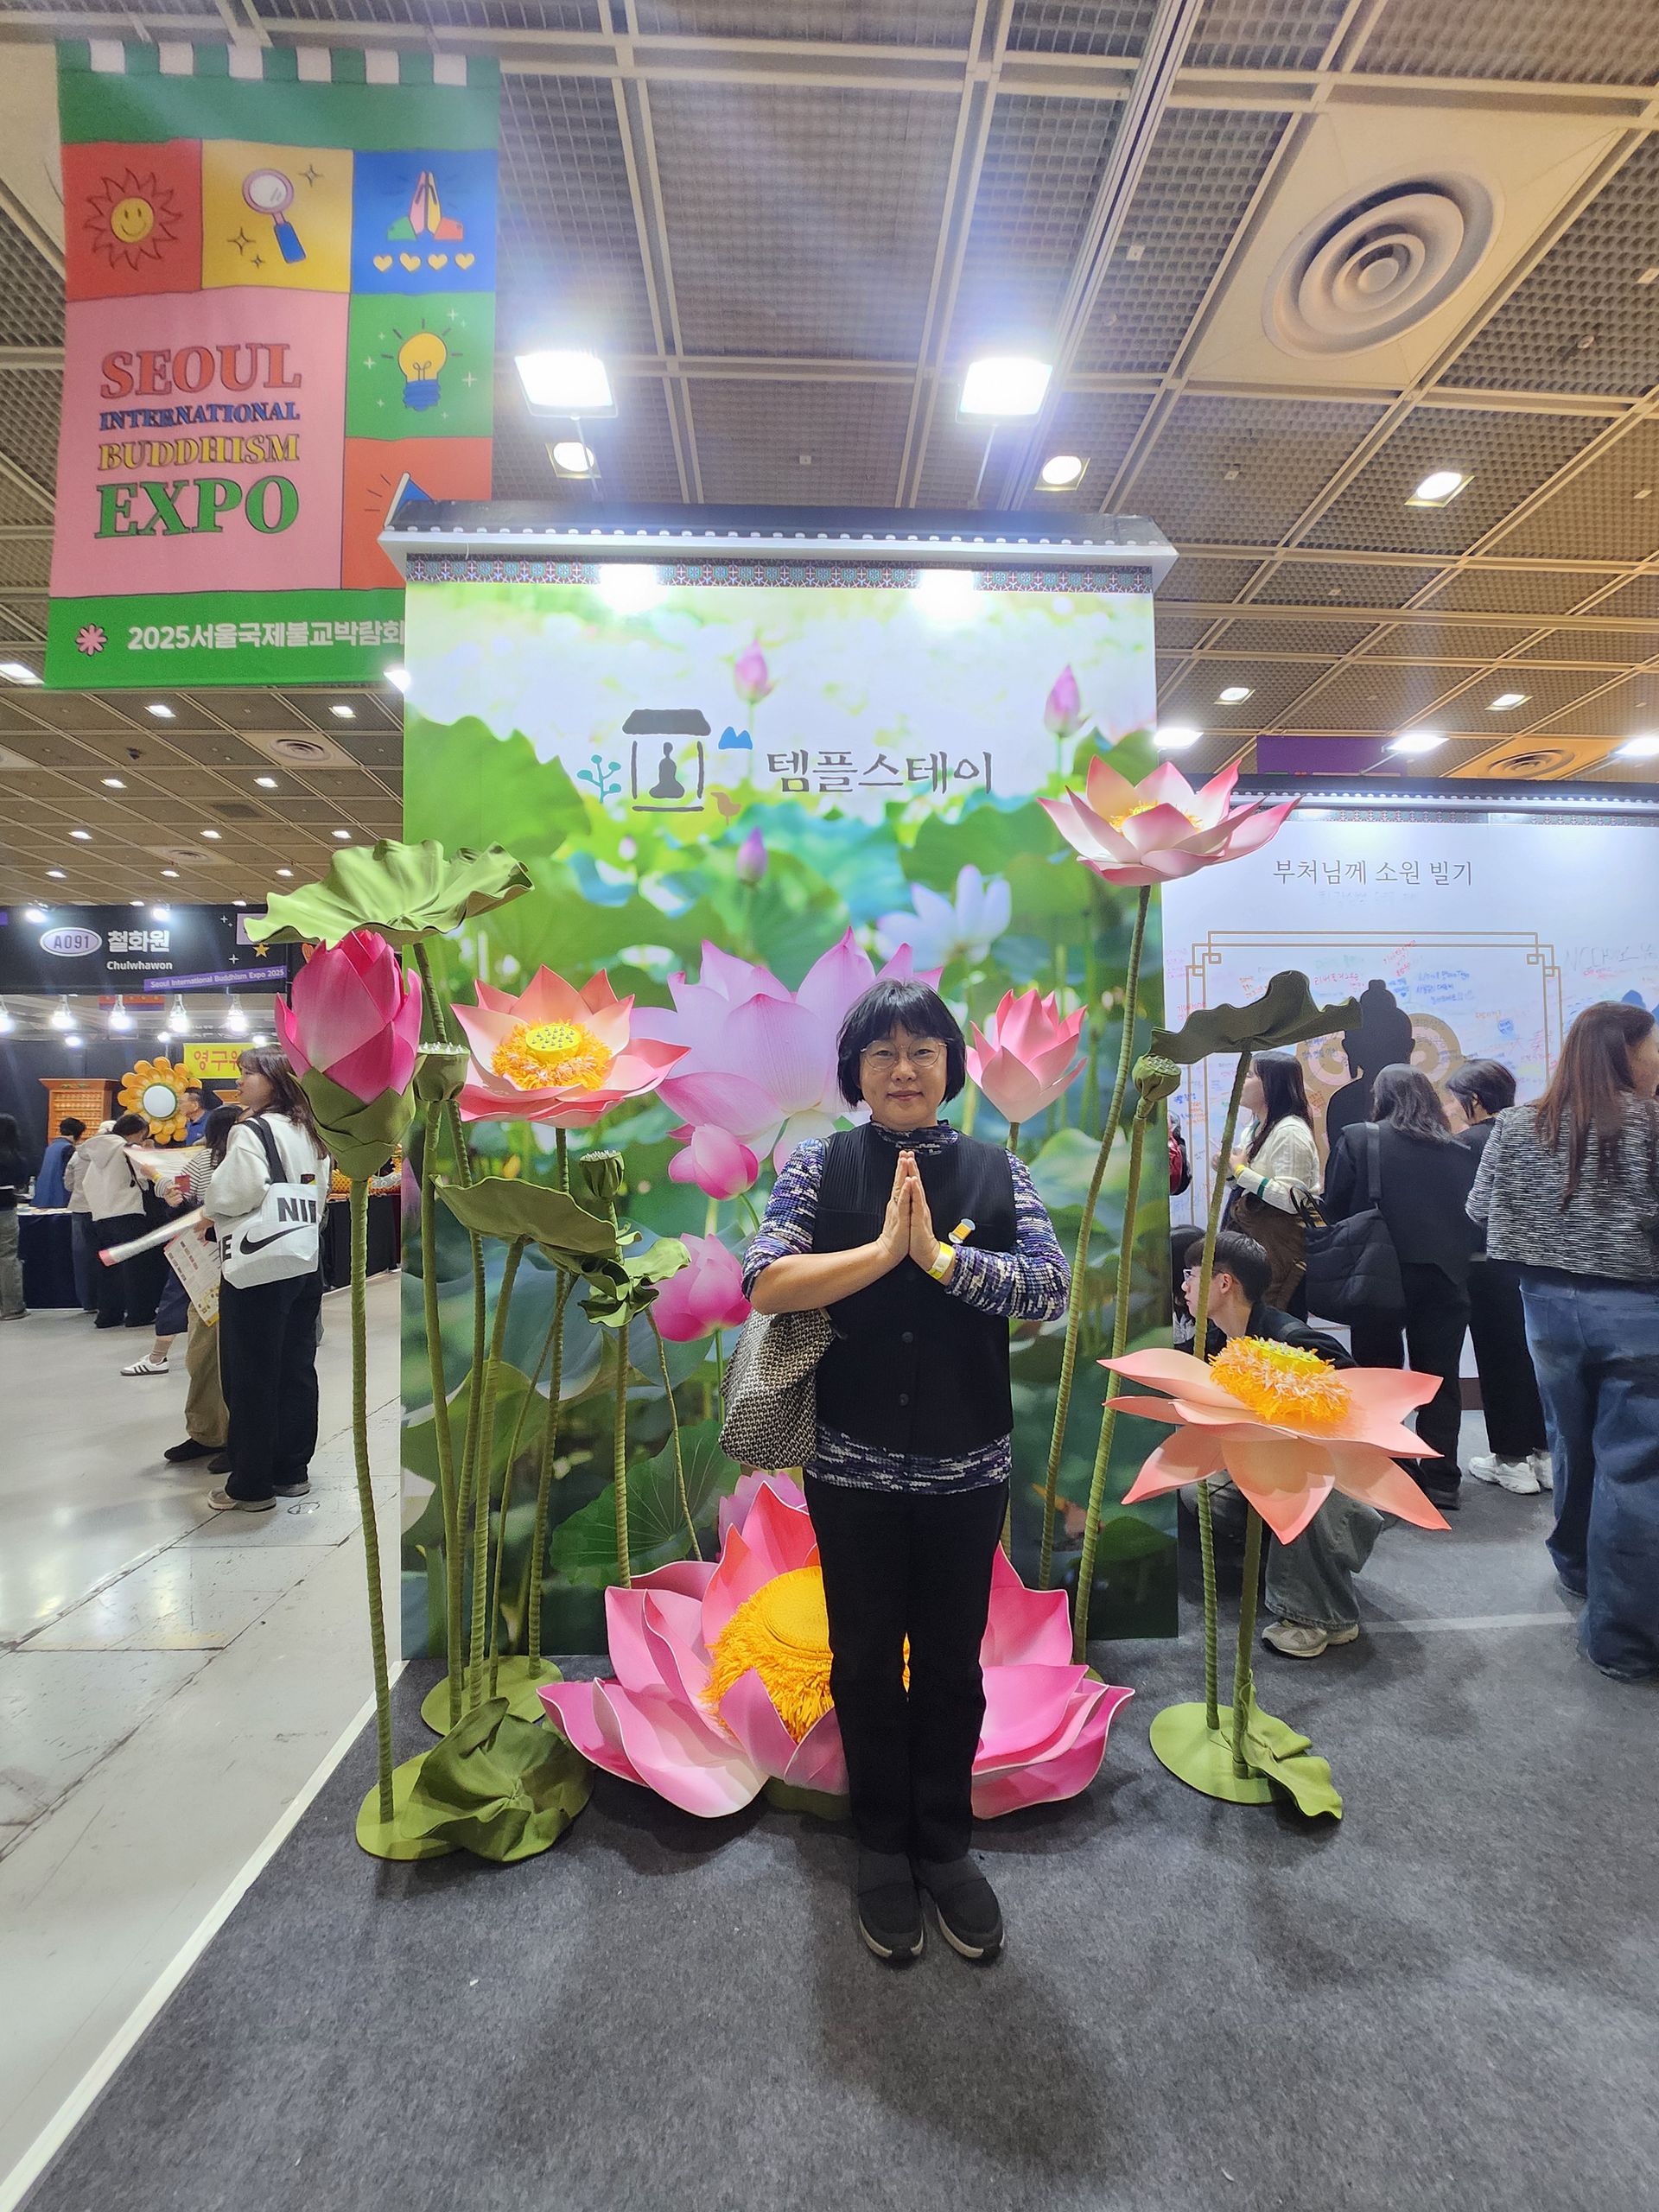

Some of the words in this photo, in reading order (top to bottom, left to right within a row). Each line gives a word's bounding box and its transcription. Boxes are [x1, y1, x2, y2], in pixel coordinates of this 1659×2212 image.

[100, 343, 302, 399] SEOUL
[99, 401, 301, 431] INTERNATIONAL
[98, 434, 300, 471] BUDDHISM
[94, 475, 300, 539] EXPO
[127, 620, 404, 650] 2025서울국제불교박람회
[766, 748, 993, 795] 템플스테이
[1273, 859, 1368, 886] 부처님께
[1375, 860, 1421, 886] 소원
[1429, 861, 1472, 887] 빌기
[53, 934, 90, 950] A091
[107, 930, 171, 953] 철화원
[106, 960, 174, 971] Chulwhawon
[150, 979, 170, 988] Seoul
[171, 976, 213, 987] International
[214, 972, 247, 982] Buddhism
[248, 970, 267, 981] Expo
[267, 969, 284, 978] 2025
